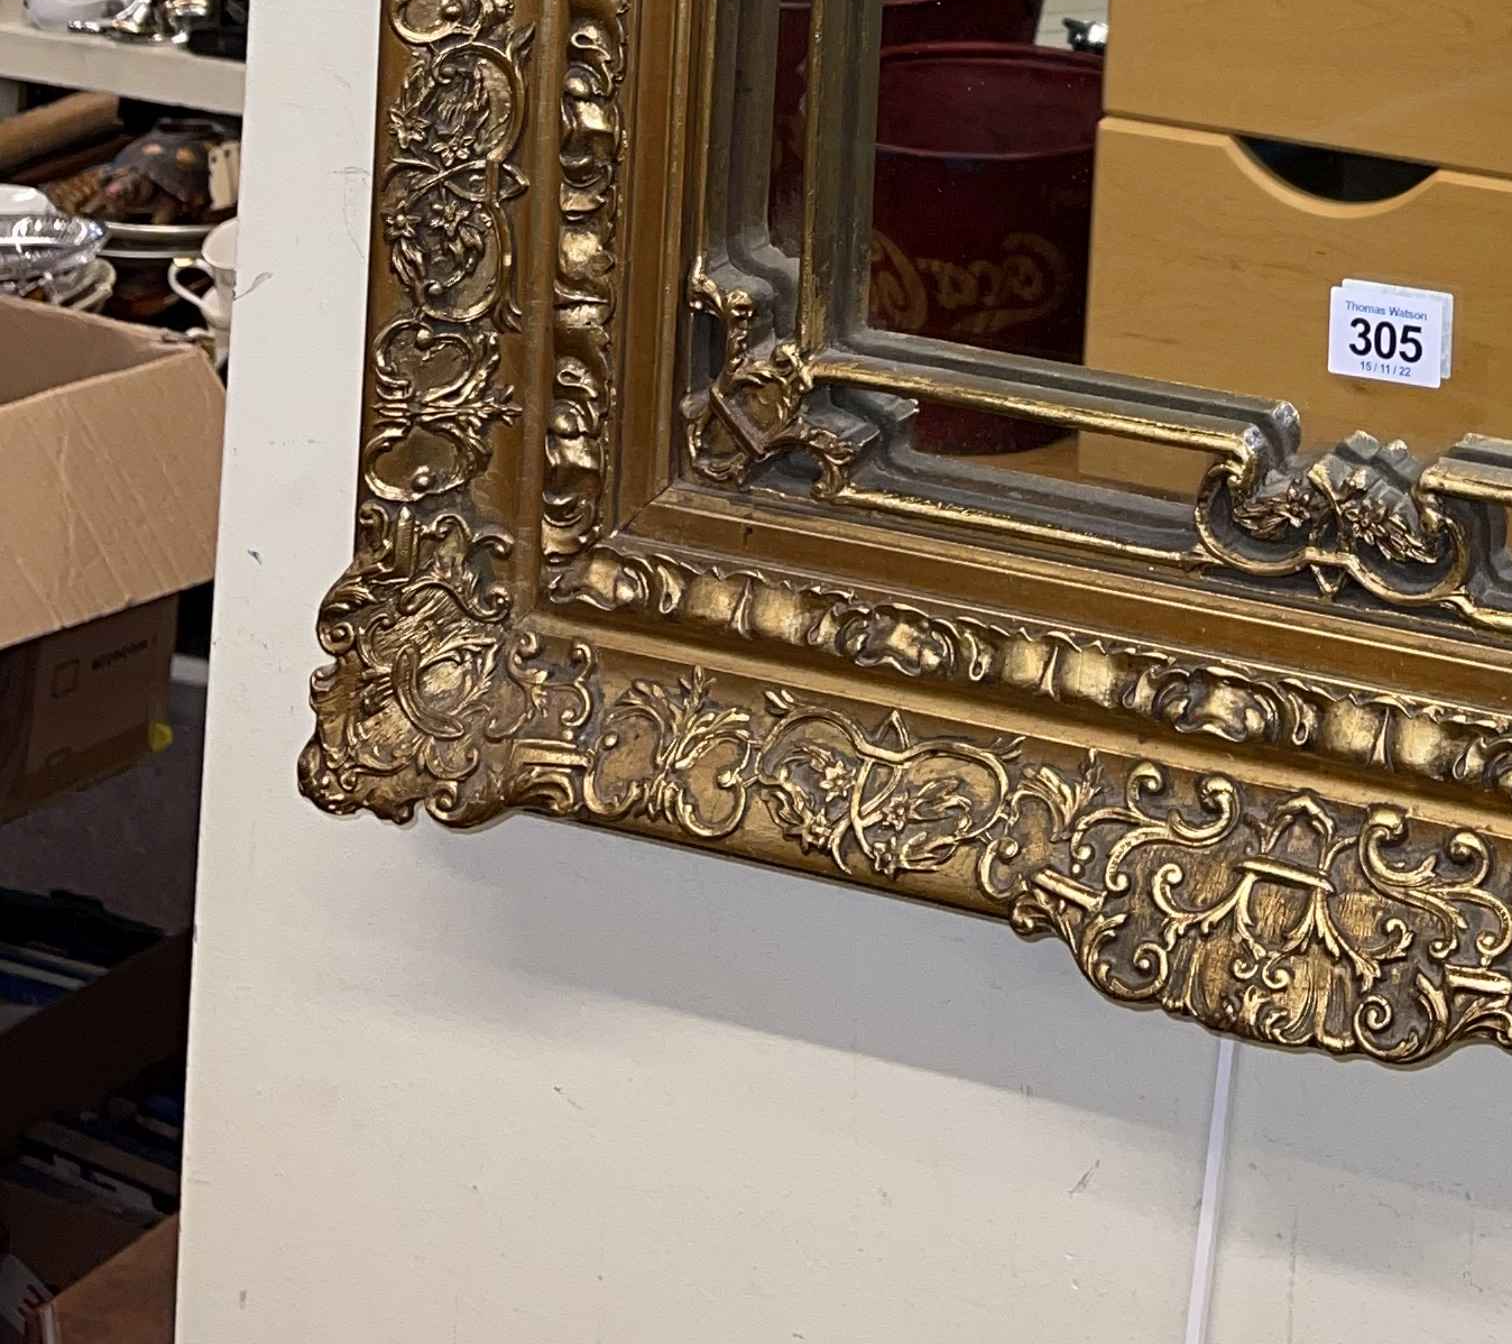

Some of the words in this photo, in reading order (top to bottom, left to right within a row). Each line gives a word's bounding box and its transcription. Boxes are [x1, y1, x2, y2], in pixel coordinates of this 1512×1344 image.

[1345, 300, 1386, 315] Thomas
[1389, 306, 1428, 320] Watson
[1349, 318, 1422, 363] 305
